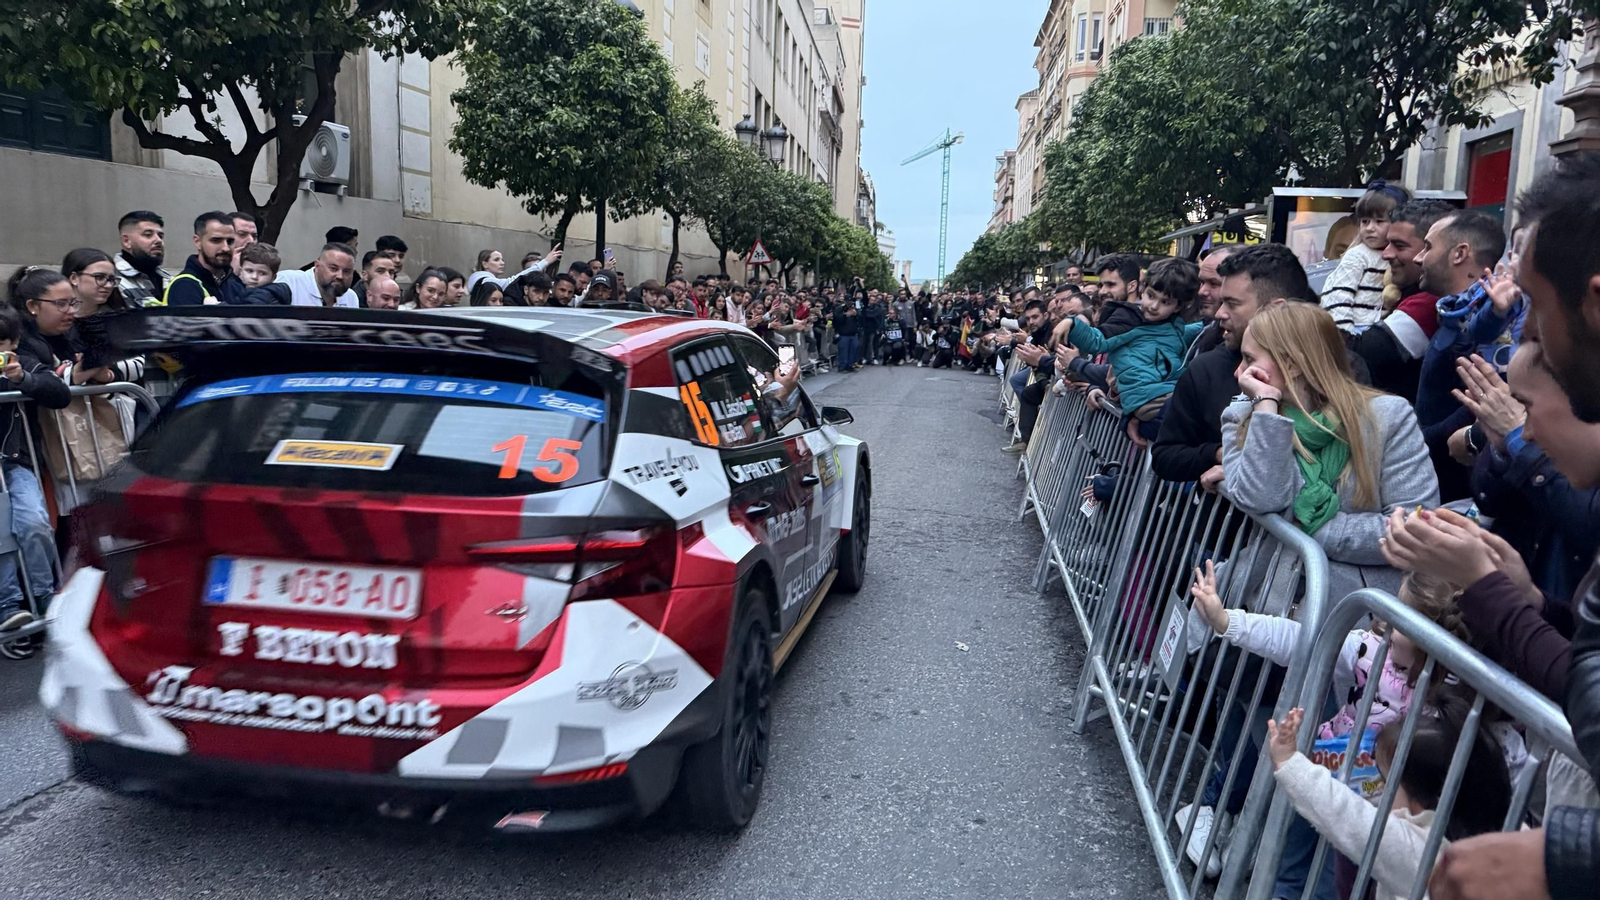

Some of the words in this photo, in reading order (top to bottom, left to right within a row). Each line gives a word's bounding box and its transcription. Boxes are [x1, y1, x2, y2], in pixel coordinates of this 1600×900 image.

[680, 381, 720, 447] 15
[491, 435, 583, 483] 15
[253, 625, 402, 669] BETON
